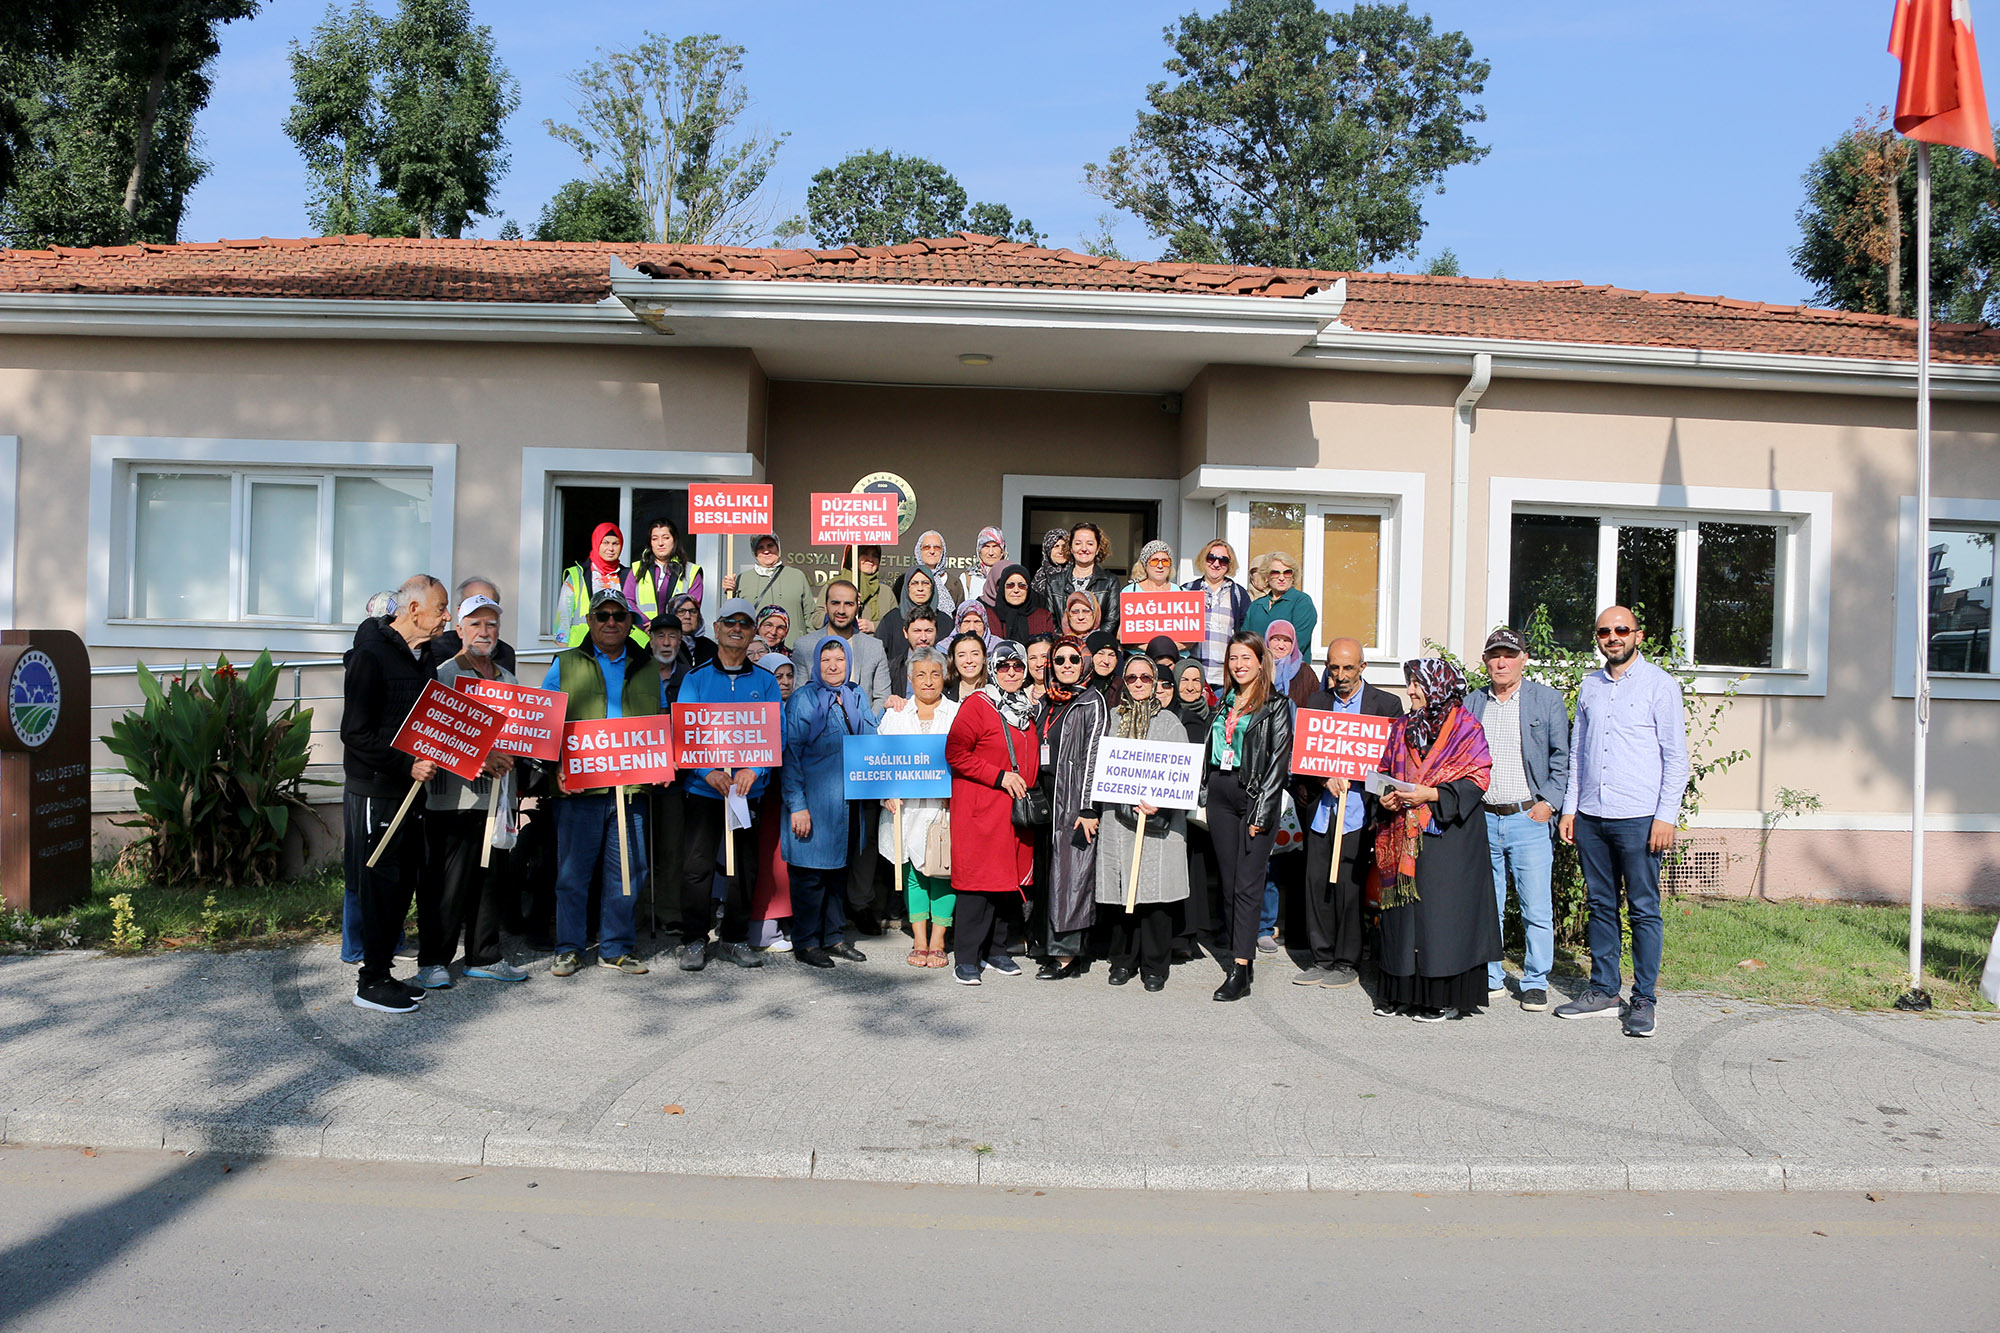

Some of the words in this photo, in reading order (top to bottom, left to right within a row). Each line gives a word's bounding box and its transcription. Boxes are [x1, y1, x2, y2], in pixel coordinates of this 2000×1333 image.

[693, 492, 768, 507] SAĞLIKLI
[821, 497, 887, 511] DÜZENLİ
[694, 509, 768, 524] BESLENİN
[821, 512, 887, 526] FİZİKSEL
[818, 529, 861, 541] AKTİVİTE
[864, 531, 891, 541] YAPIN
[787, 552, 839, 565] SOSYAL
[1124, 600, 1200, 615] SAĞLIKLI
[1125, 616, 1200, 632] BESLENİN
[464, 684, 514, 701] KİLOLU
[517, 692, 553, 707] VEYA
[430, 689, 468, 713] KİLOLU
[467, 706, 494, 727] VEYA
[508, 708, 544, 721] OLUP
[684, 707, 767, 725] DÜZENLİ
[426, 707, 455, 727] OBEZ
[453, 720, 482, 738] OLUP
[501, 722, 551, 740] IĞINIZI
[1308, 716, 1393, 740] DÜZENLİ
[411, 720, 480, 758] OLMADIĞINIZI
[567, 729, 665, 751] SAĞLIKLI
[684, 727, 768, 744] FİZİKSEL
[412, 739, 460, 768] ÖĞRENİN
[493, 738, 533, 753] RENİN
[569, 749, 667, 774] BESLENİN
[680, 748, 735, 763] AKTİVİTE
[738, 749, 773, 762] YAPIN
[914, 752, 930, 765] BİR
[1109, 749, 1192, 766] ALZHEİMER'DEN
[1299, 756, 1356, 775] AKTİVİTE
[849, 770, 892, 781] GELECEK
[1105, 765, 1165, 781] KORUNMAK
[1168, 768, 1190, 784] İÇİN
[1097, 781, 1147, 796] EGZERSİZ
[1151, 786, 1194, 800] YAPALIM
